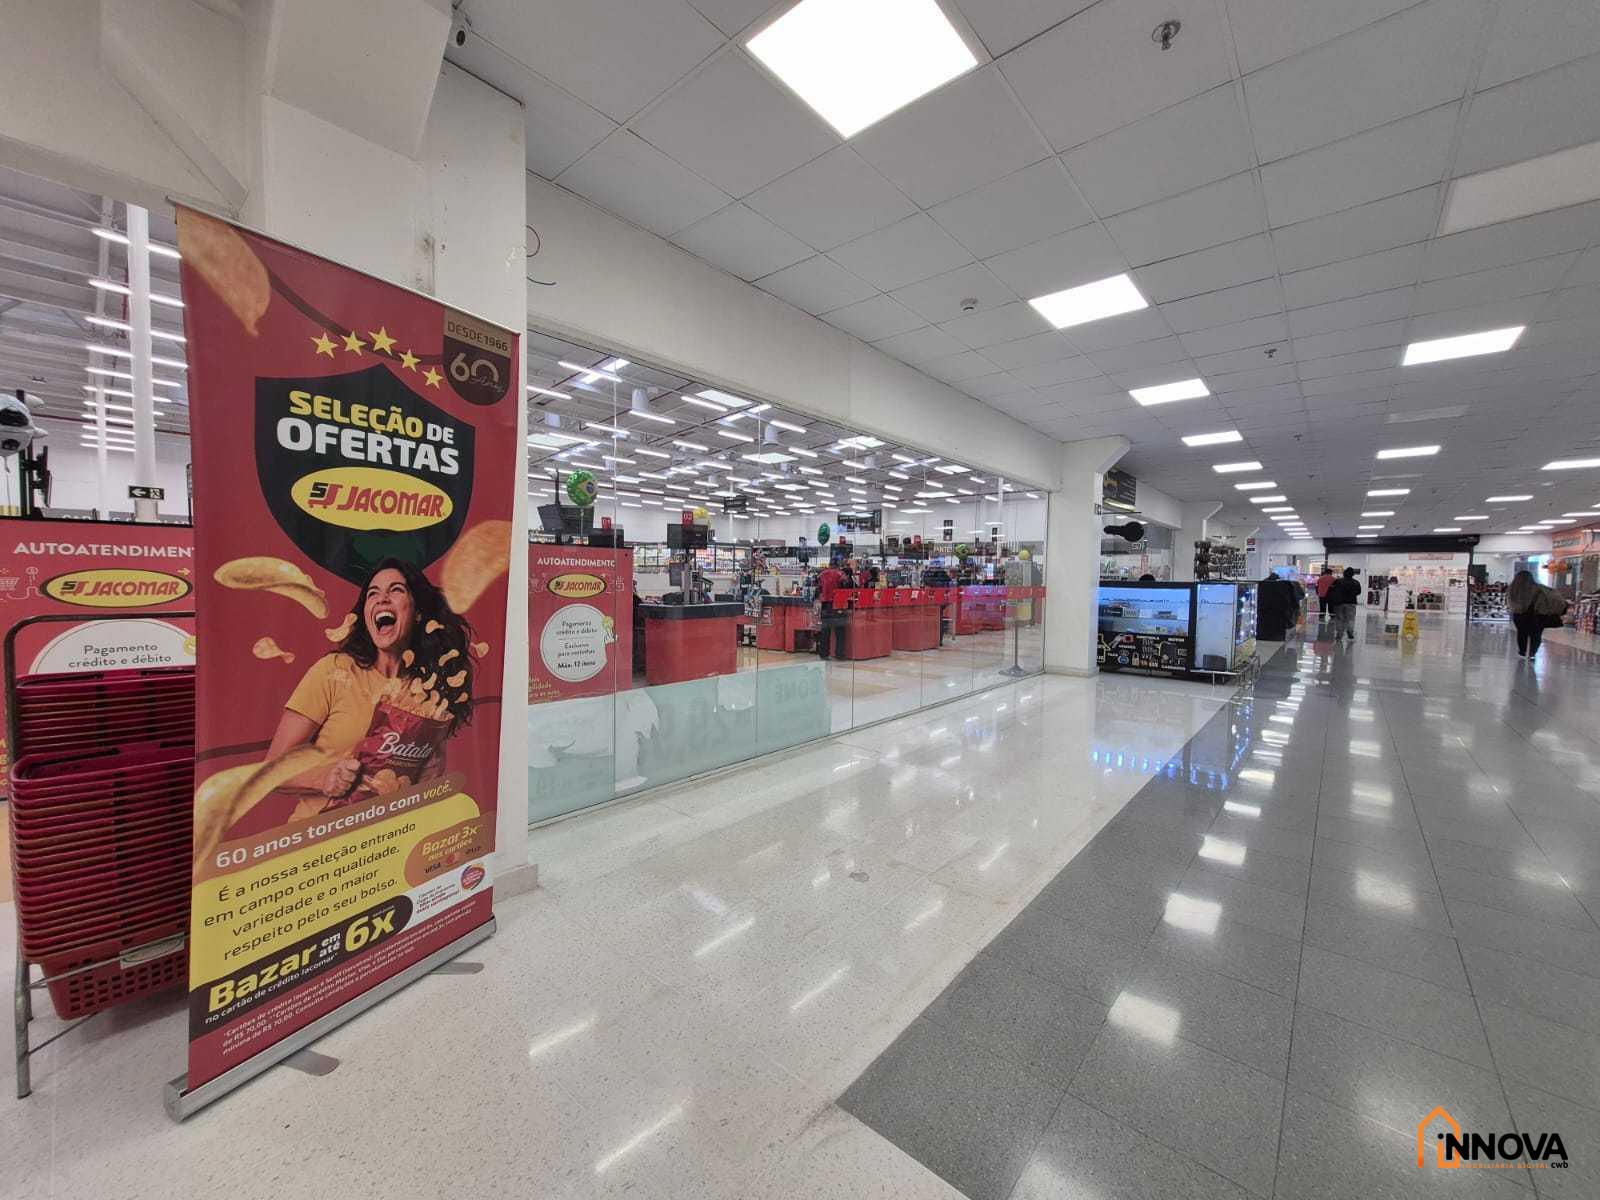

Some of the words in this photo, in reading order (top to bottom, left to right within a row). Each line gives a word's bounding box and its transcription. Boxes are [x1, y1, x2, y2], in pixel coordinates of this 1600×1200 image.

[289, 390, 424, 438] SELEÇÃO
[426, 422, 455, 445] DE
[276, 417, 460, 475] OFERTAS
[336, 486, 444, 517] JACOMAR
[14, 542, 195, 557] AUTOATENDIMEN
[84, 581, 179, 596] JACOMAR
[69, 657, 116, 668] crédito
[121, 657, 127, 665] e
[132, 655, 172, 665] débito
[84, 644, 158, 657] Pagamento
[216, 847, 248, 868] 60
[253, 831, 303, 858] anos
[306, 804, 386, 840] torcendo
[389, 794, 421, 812] com
[422, 832, 460, 856] Bazar
[218, 885, 230, 902] É
[235, 887, 246, 897] a
[250, 866, 299, 891] nossa
[303, 845, 357, 871] seleção
[360, 822, 416, 850] entrando
[204, 910, 234, 927] em
[239, 886, 294, 915] campo
[298, 872, 330, 891] com
[224, 923, 293, 961] respeito
[297, 907, 330, 930] pelo
[333, 895, 357, 912] seu
[360, 878, 398, 899] bolso.
[232, 897, 313, 937] variedade
[317, 891, 326, 901] e
[329, 886, 338, 896] o
[341, 869, 379, 893] maior
[319, 941, 341, 958] até
[321, 931, 341, 948] em
[345, 908, 396, 953] 6x
[205, 1013, 220, 1025] no
[221, 996, 253, 1016] cartão
[254, 987, 267, 999] de
[268, 973, 300, 994] crédito
[208, 943, 318, 1013] Bazar
